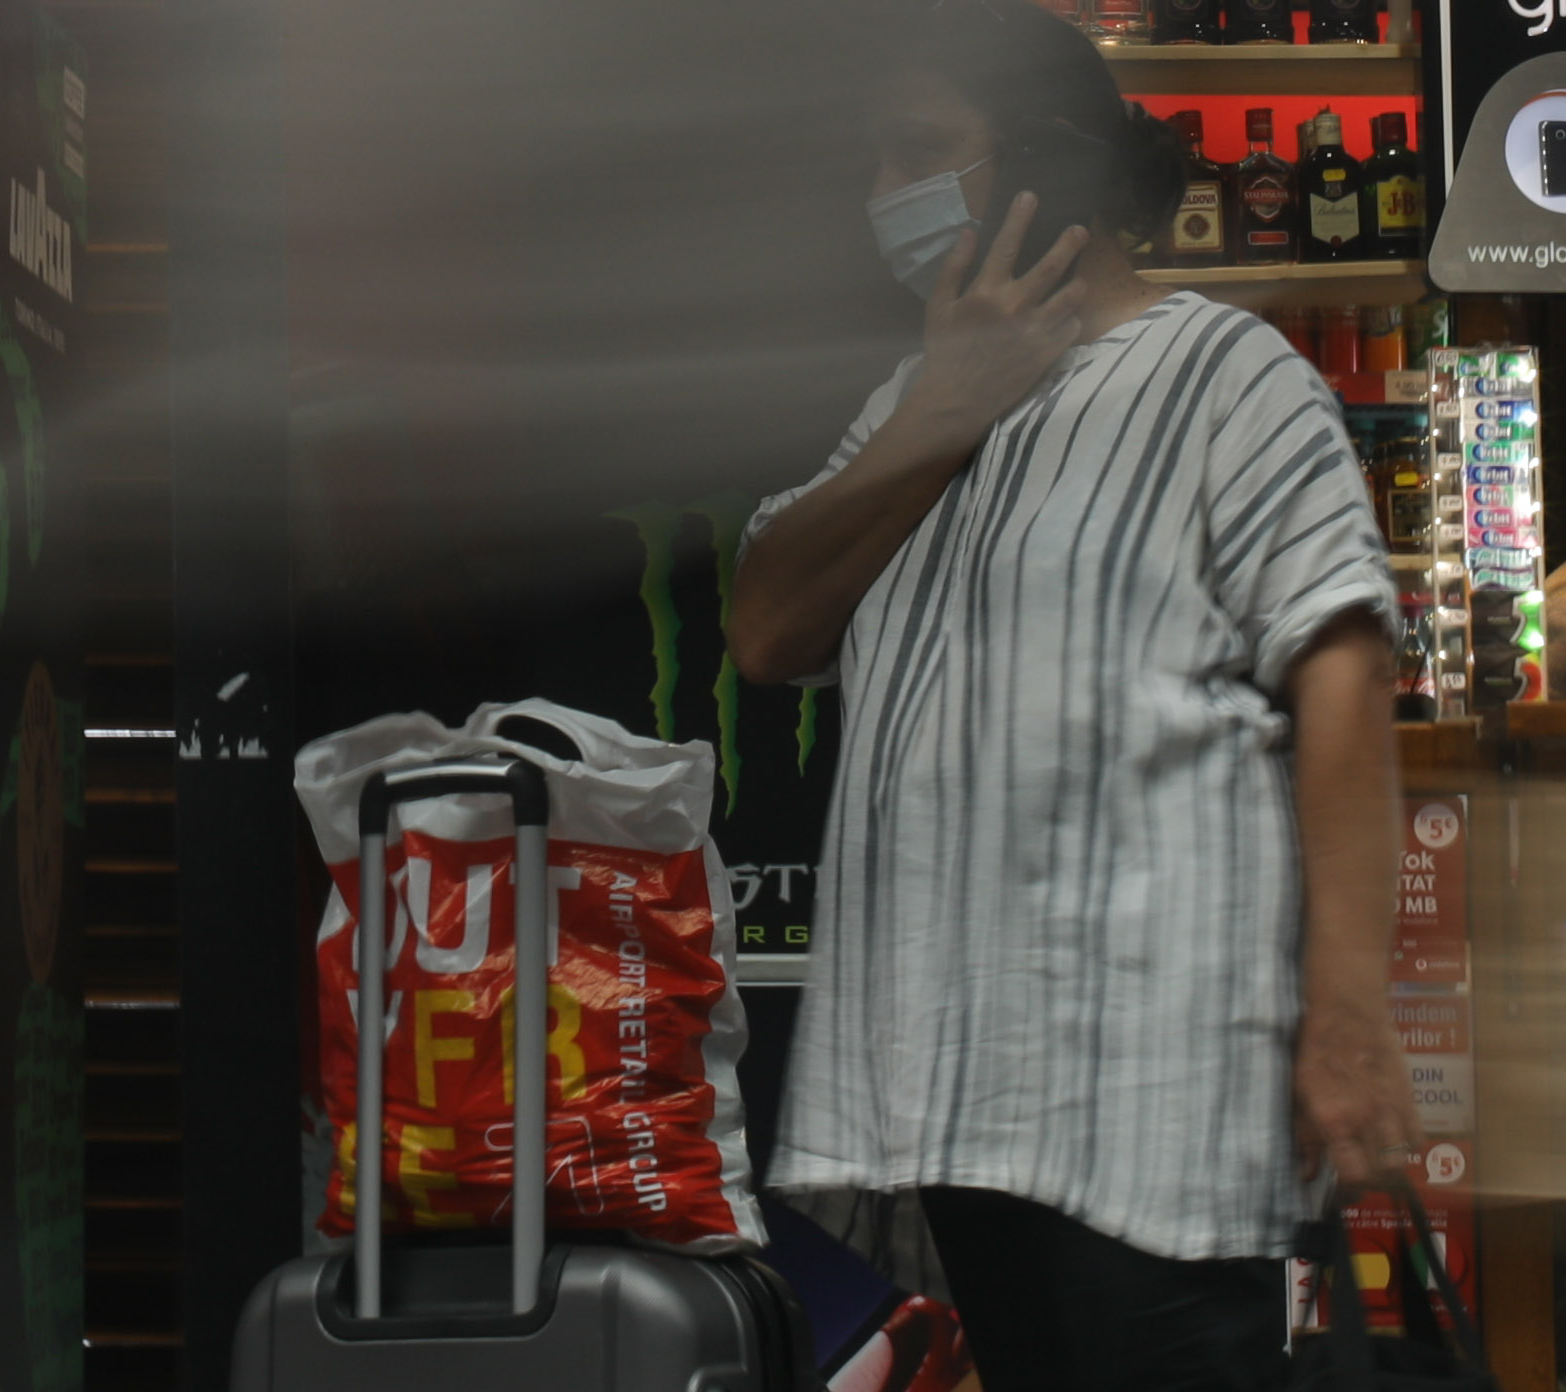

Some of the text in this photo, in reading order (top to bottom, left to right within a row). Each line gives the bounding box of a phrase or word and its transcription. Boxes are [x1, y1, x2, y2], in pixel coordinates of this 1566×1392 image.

[608, 870, 648, 989] AIRPORT
[1405, 896, 1438, 914] MB
[617, 998, 650, 1105] RETAIL
[620, 1110, 668, 1214] GROUP
